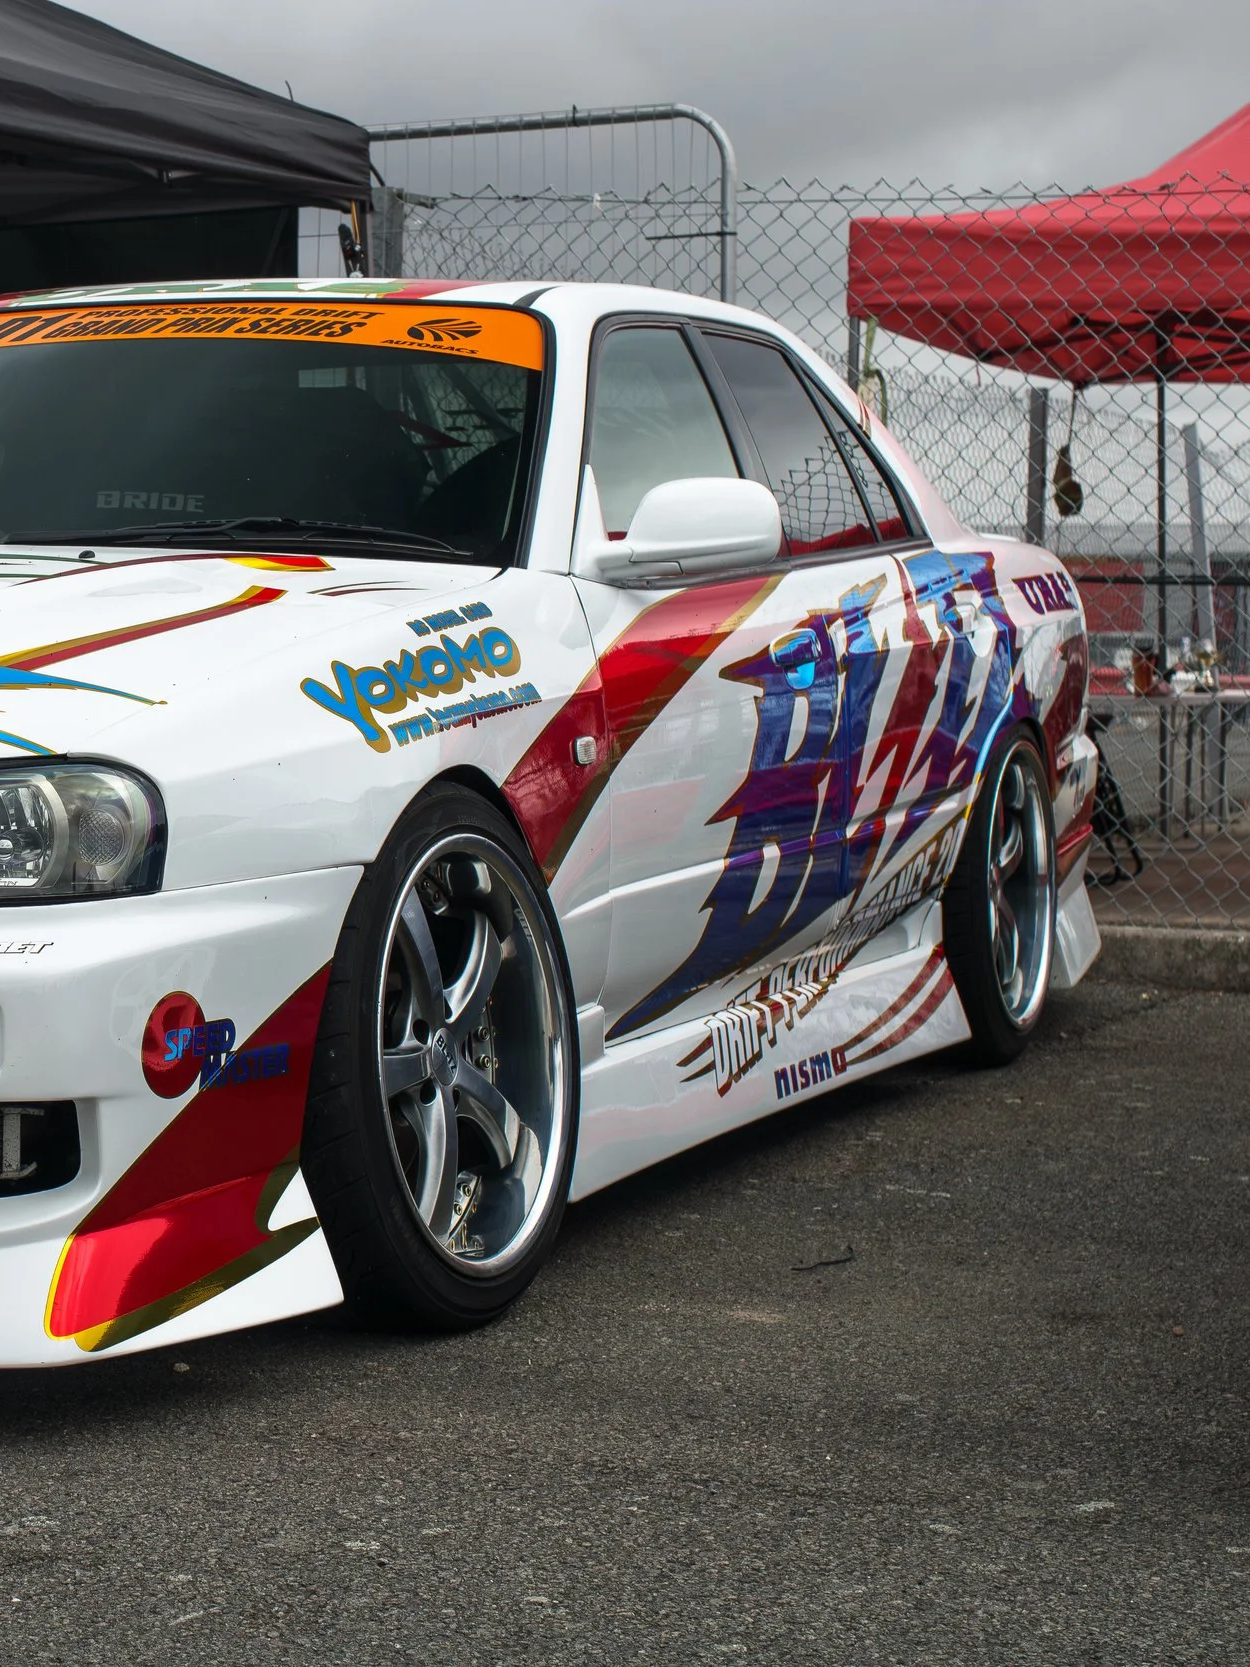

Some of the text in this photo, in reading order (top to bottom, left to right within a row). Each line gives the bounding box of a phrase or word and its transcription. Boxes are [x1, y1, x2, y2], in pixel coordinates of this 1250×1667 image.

[76, 305, 385, 320] PROFESSIONAL DRIFT
[41, 317, 160, 339] GRAND
[153, 316, 240, 335] PRIX
[234, 317, 367, 339] SERIES
[380, 339, 478, 355] AUTOBACS
[96, 490, 205, 513] BRIDE
[422, 608, 468, 632] MODEL
[300, 627, 521, 753] YOKOMO
[163, 1018, 236, 1062] SPEED
[199, 1042, 291, 1092] MASTER
[773, 1047, 849, 1100] nismo
